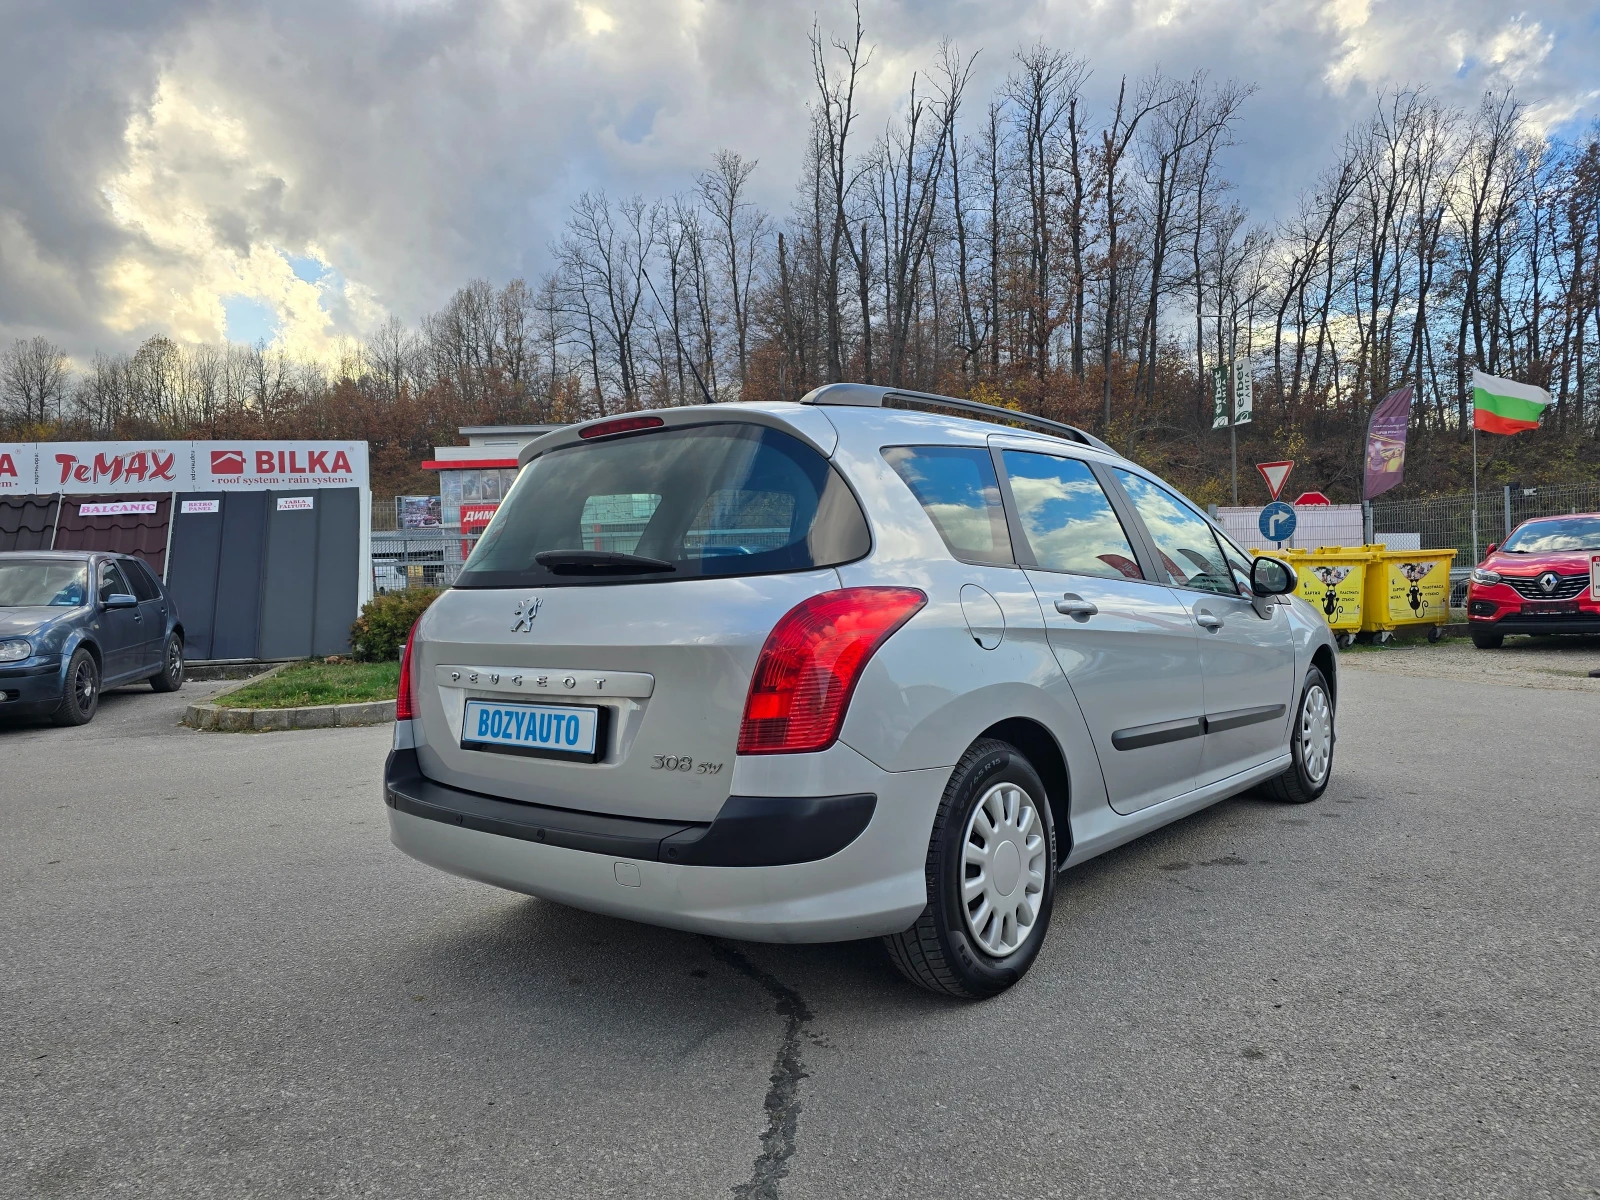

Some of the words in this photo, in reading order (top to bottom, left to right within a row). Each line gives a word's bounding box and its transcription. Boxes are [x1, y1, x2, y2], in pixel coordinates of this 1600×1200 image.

[1214, 370, 1222, 414] efbet
[1236, 363, 1244, 408] efbet
[55, 451, 176, 485] TeMAX
[255, 450, 353, 474] BILKA
[217, 475, 242, 484] roof
[242, 477, 279, 486] system
[288, 475, 310, 484] rain
[312, 476, 348, 485] system
[81, 503, 156, 514] BALCANIC
[451, 671, 606, 690] PEUGEOT
[477, 708, 580, 746] BOZYAUTO
[650, 754, 693, 772] 308
